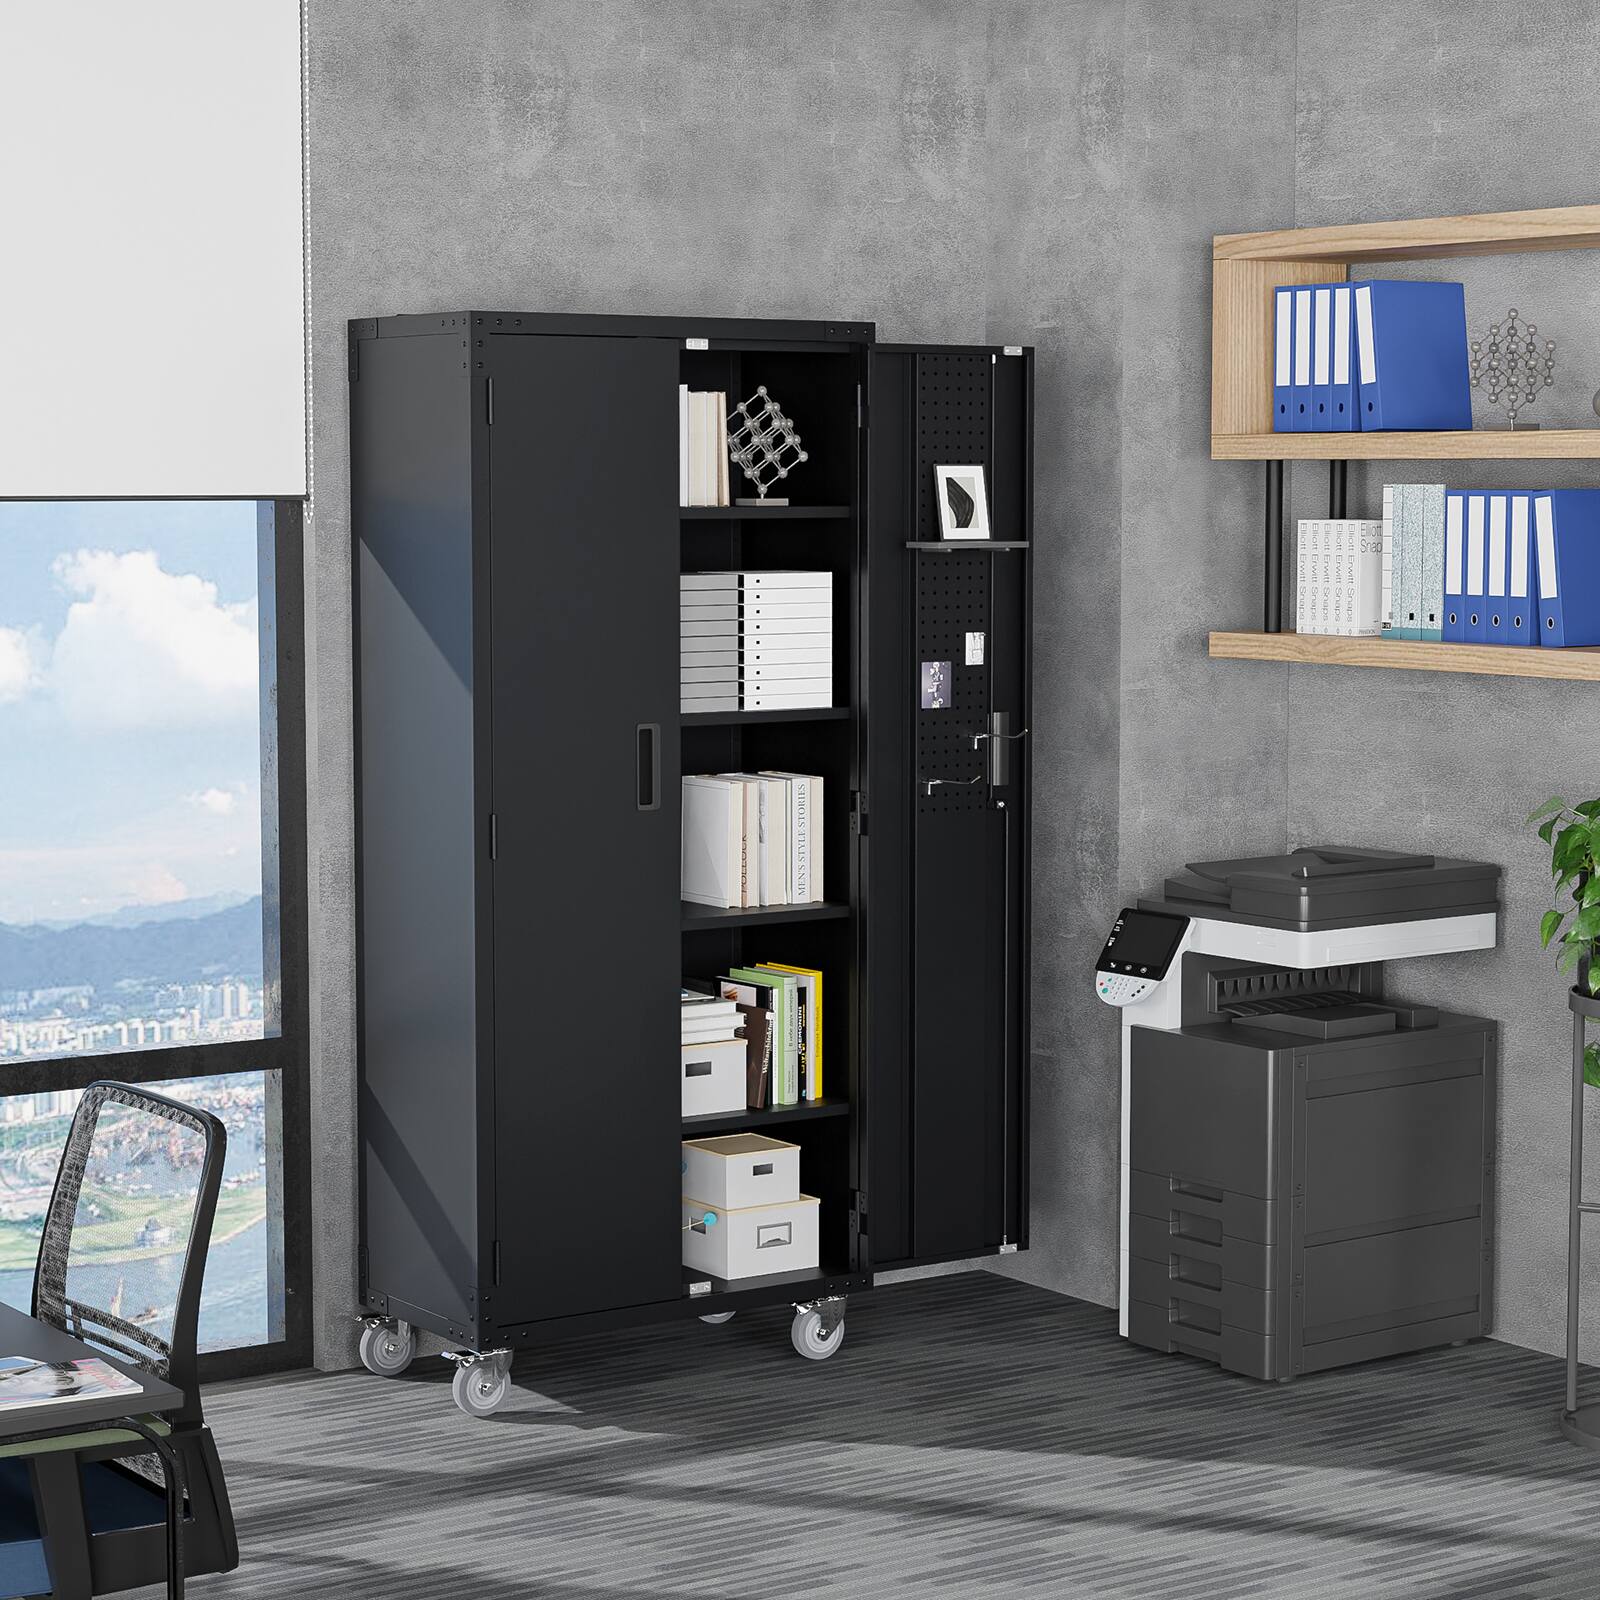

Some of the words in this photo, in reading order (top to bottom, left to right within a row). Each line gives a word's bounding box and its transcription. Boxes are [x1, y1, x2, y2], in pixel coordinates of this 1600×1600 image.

[1300, 523, 1308, 550] Elliott
[1312, 523, 1320, 550] Elliott
[1336, 524, 1344, 551] Elliott
[1348, 524, 1356, 551] Elliott
[1361, 523, 1382, 537] Elliott
[1360, 539, 1382, 555] Snap
[1300, 554, 1308, 582] Erwitt
[1312, 554, 1320, 583] Erwitt
[1299, 586, 1307, 620] Snaps
[1311, 586, 1319, 621] Snaps
[1323, 587, 1331, 621] Snaps
[1335, 587, 1343, 622] Snaps
[1347, 587, 1355, 622] Snaps
